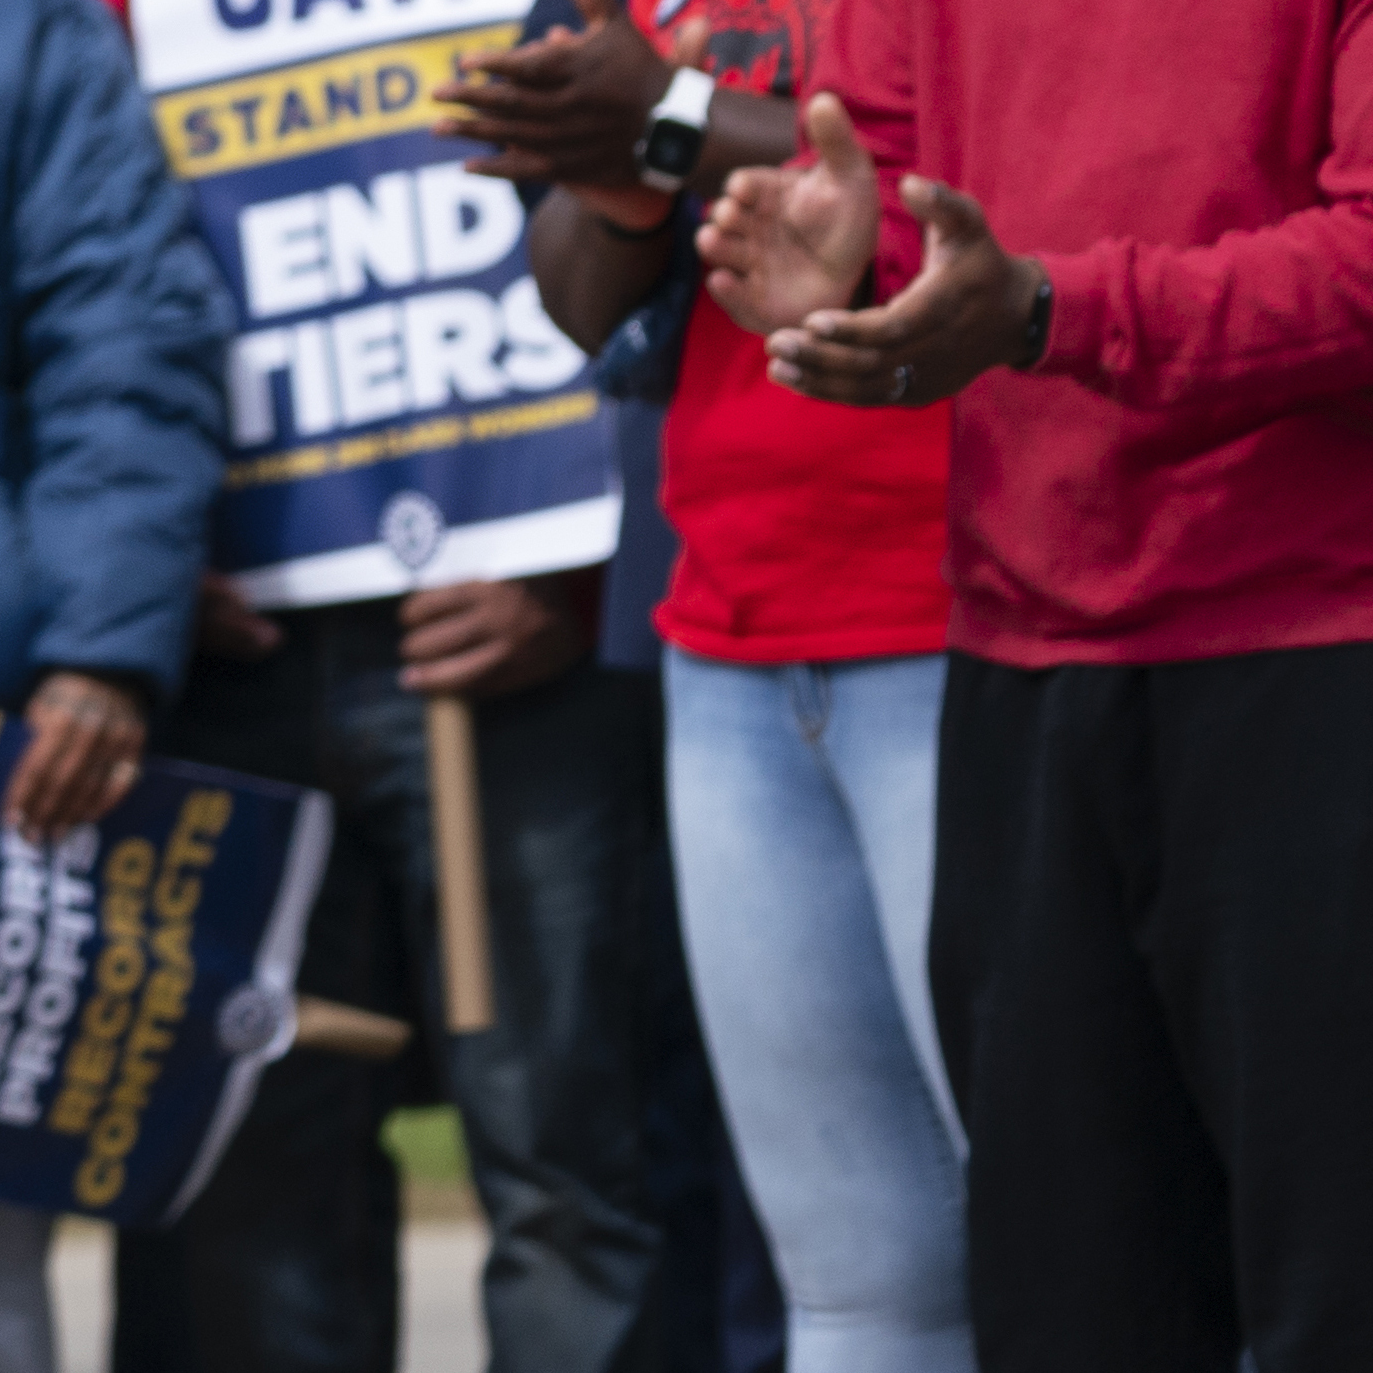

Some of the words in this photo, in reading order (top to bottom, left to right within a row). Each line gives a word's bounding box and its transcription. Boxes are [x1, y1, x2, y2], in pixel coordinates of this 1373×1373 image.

[179, 63, 422, 162] STAND
[238, 162, 527, 319] END
[226, 274, 590, 449] TIERS
[50, 837, 156, 1135] RECORD
[73, 790, 235, 1207] CONTRACTS
